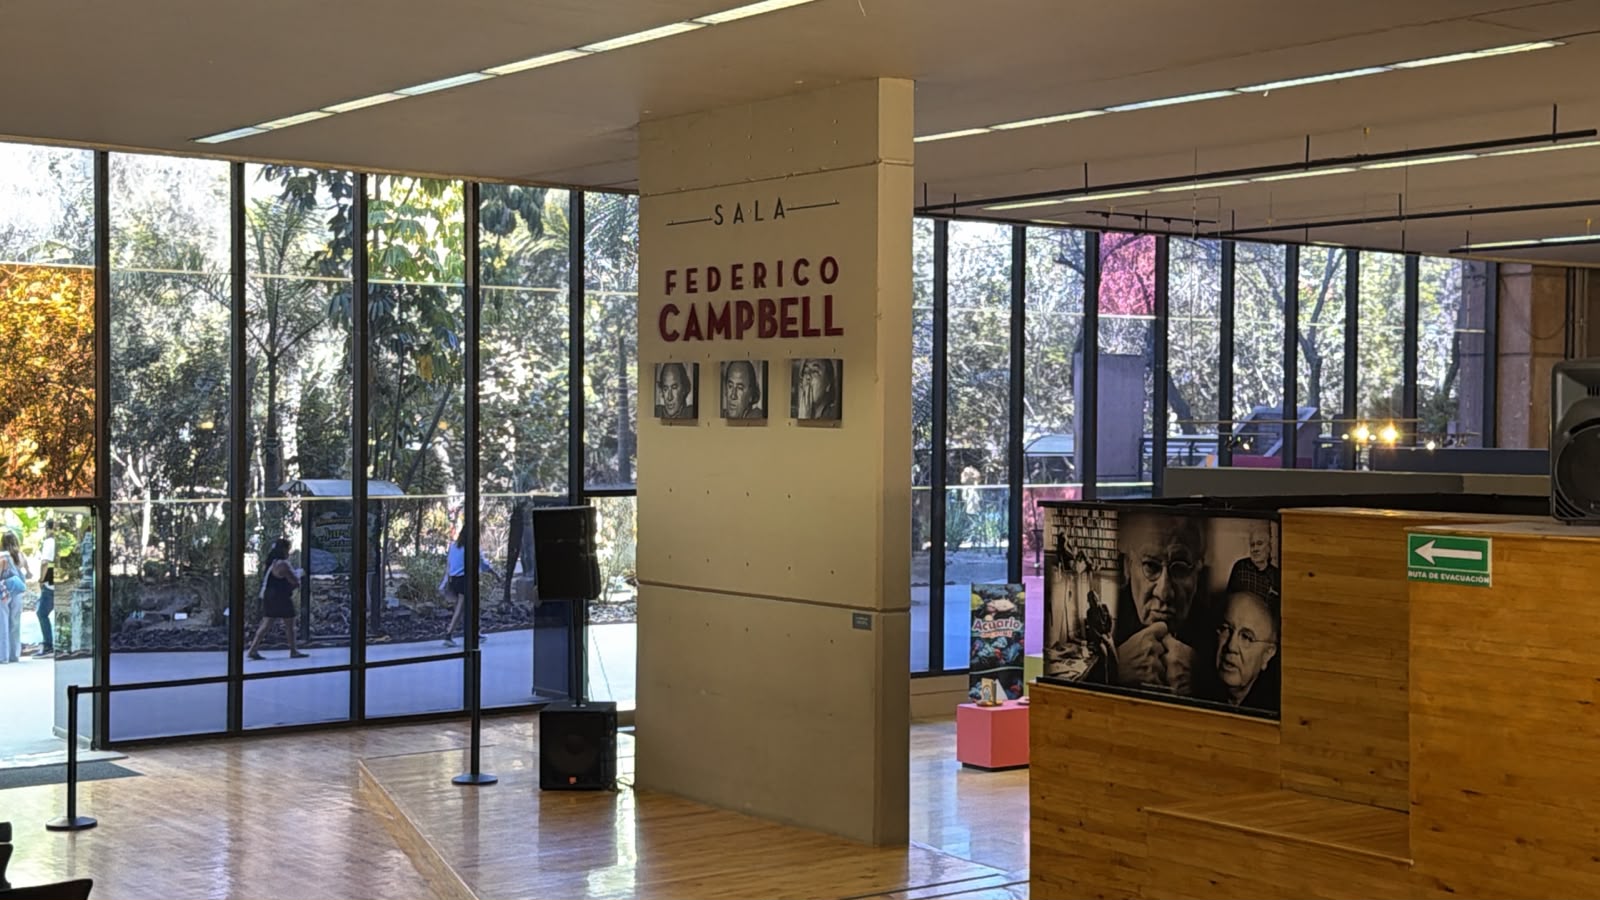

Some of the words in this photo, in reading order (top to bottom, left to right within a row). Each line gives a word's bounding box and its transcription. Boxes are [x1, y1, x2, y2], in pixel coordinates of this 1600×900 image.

[714, 198, 785, 226] SALA
[665, 256, 839, 295] FEDERICO
[658, 294, 844, 342] CAMPBELL
[1408, 570, 1427, 578] RUTA
[1440, 573, 1489, 583] EVACUACIÓN
[973, 618, 1021, 631] Acuario
